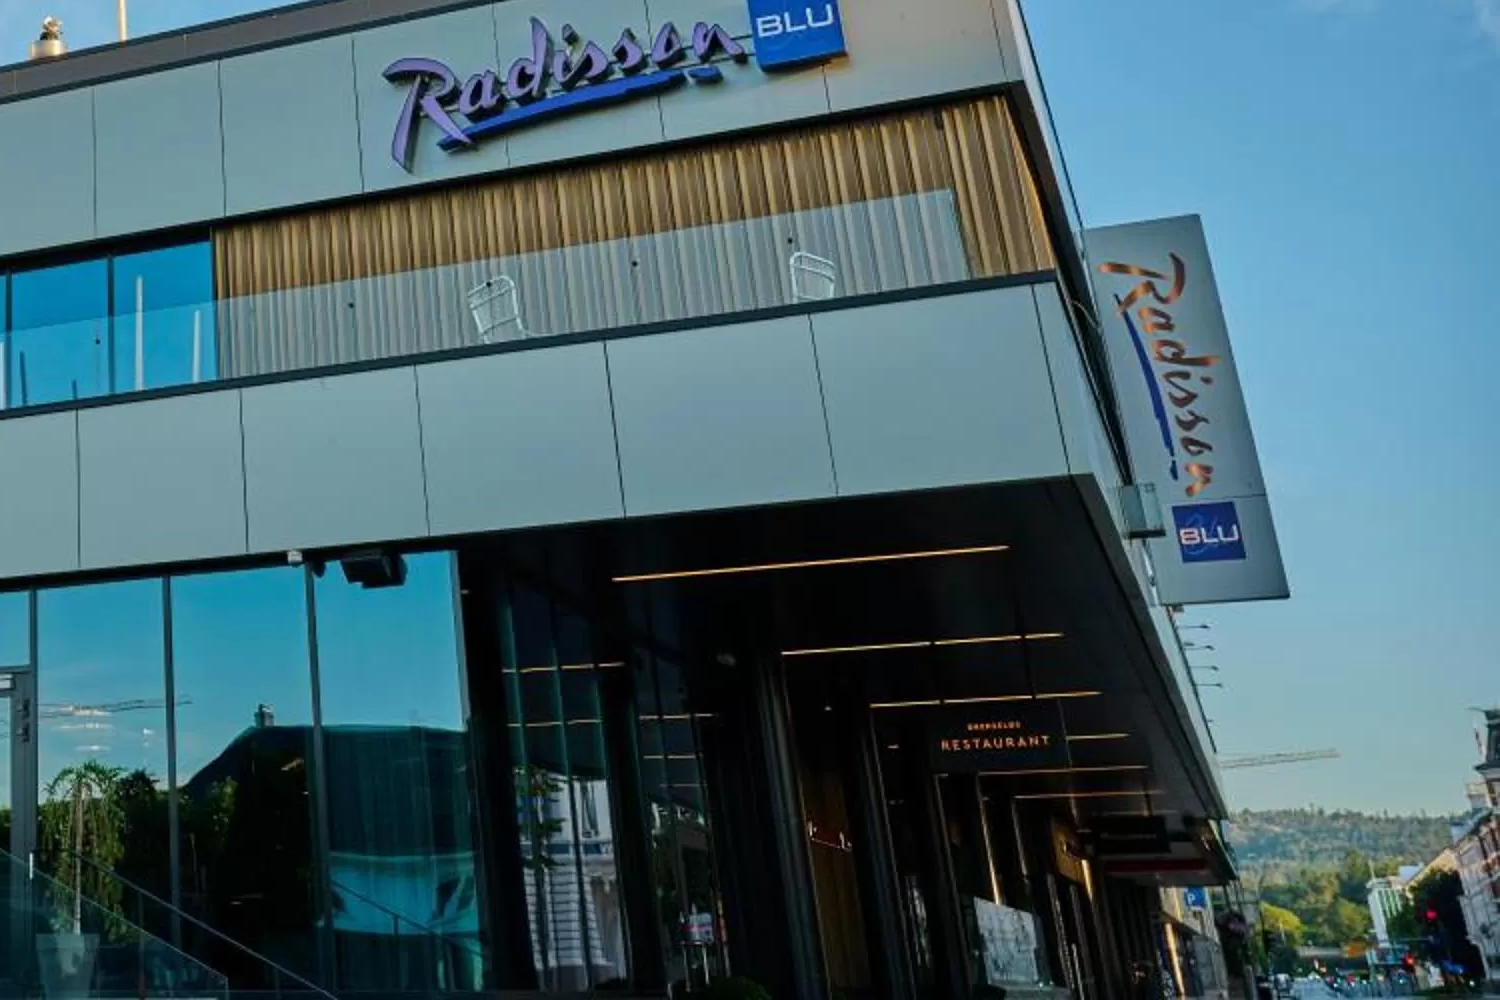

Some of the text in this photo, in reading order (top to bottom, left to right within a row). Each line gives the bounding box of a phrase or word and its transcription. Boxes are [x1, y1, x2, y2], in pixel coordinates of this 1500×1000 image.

[382, 3, 835, 174] Radisson BLU
[1098, 251, 1221, 497] Radisson
[1179, 524, 1240, 546] BLU
[940, 735, 1050, 751] RESTAURANT
